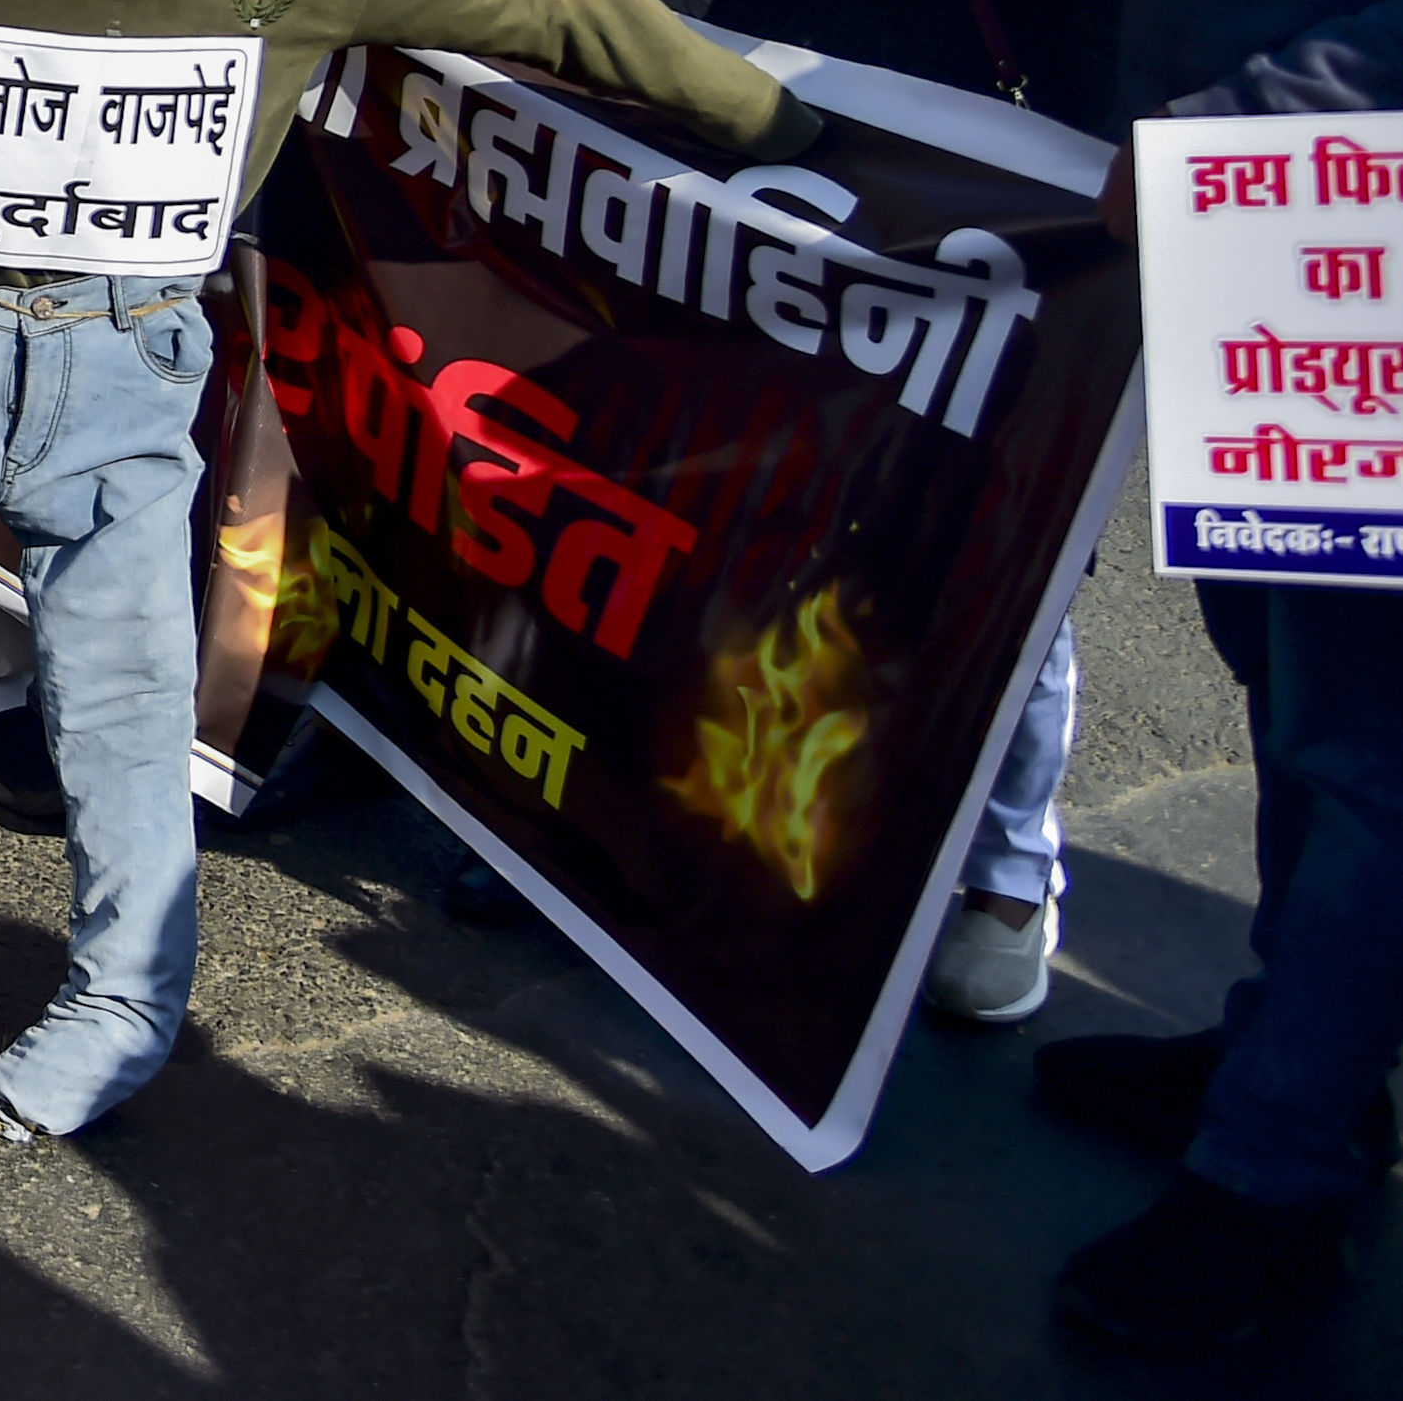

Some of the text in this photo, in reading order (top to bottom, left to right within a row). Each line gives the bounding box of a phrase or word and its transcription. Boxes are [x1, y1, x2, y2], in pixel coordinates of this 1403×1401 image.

[1186, 154, 1291, 213] इस
[1300, 246, 1385, 300] का
[336, 325, 698, 661] पंडित
[406, 606, 587, 813] दहन
